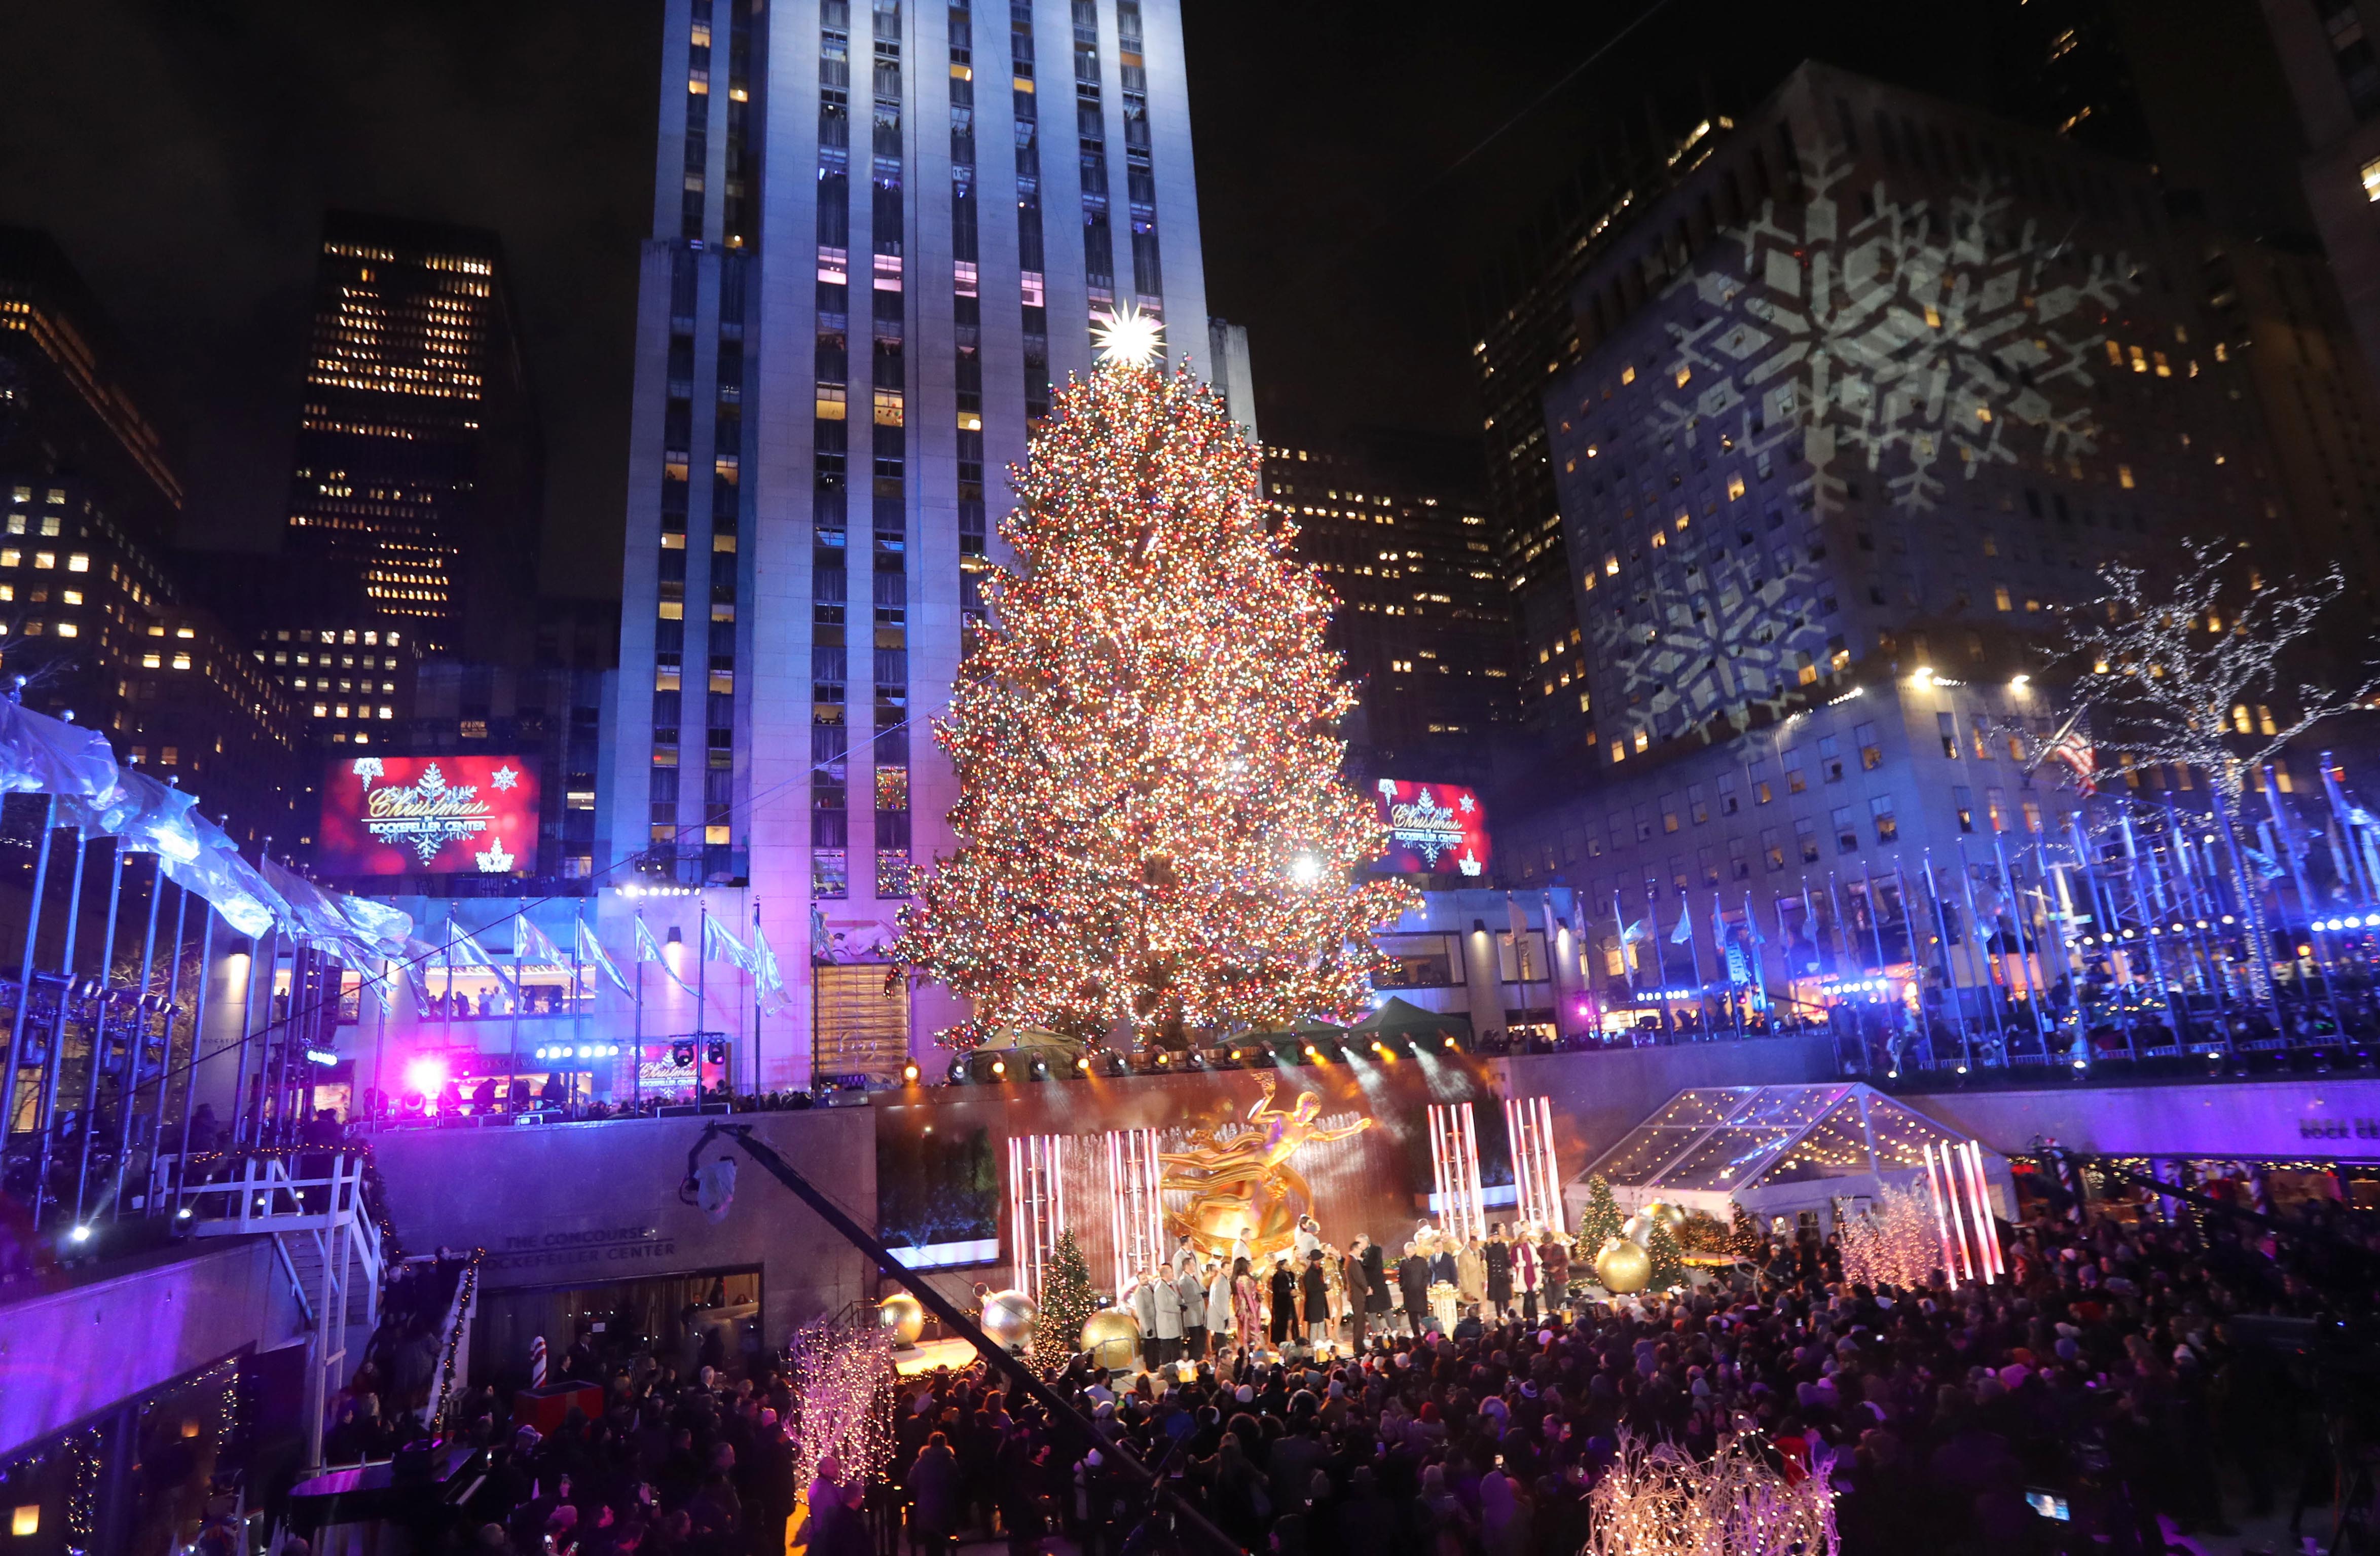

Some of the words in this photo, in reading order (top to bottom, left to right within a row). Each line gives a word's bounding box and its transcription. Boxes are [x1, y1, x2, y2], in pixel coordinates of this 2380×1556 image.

[369, 787, 490, 817] Christmas
[1391, 803, 1462, 830] Christmas
[370, 822, 441, 833] ROCKEFELLER
[445, 821, 487, 831] CENTER
[1395, 831, 1437, 841] ROCKEFELLER
[1438, 834, 1463, 843] CENTER
[505, 1236, 536, 1249] THE
[544, 1227, 648, 1246] CONCOURSE
[607, 1244, 675, 1261] CENTER
